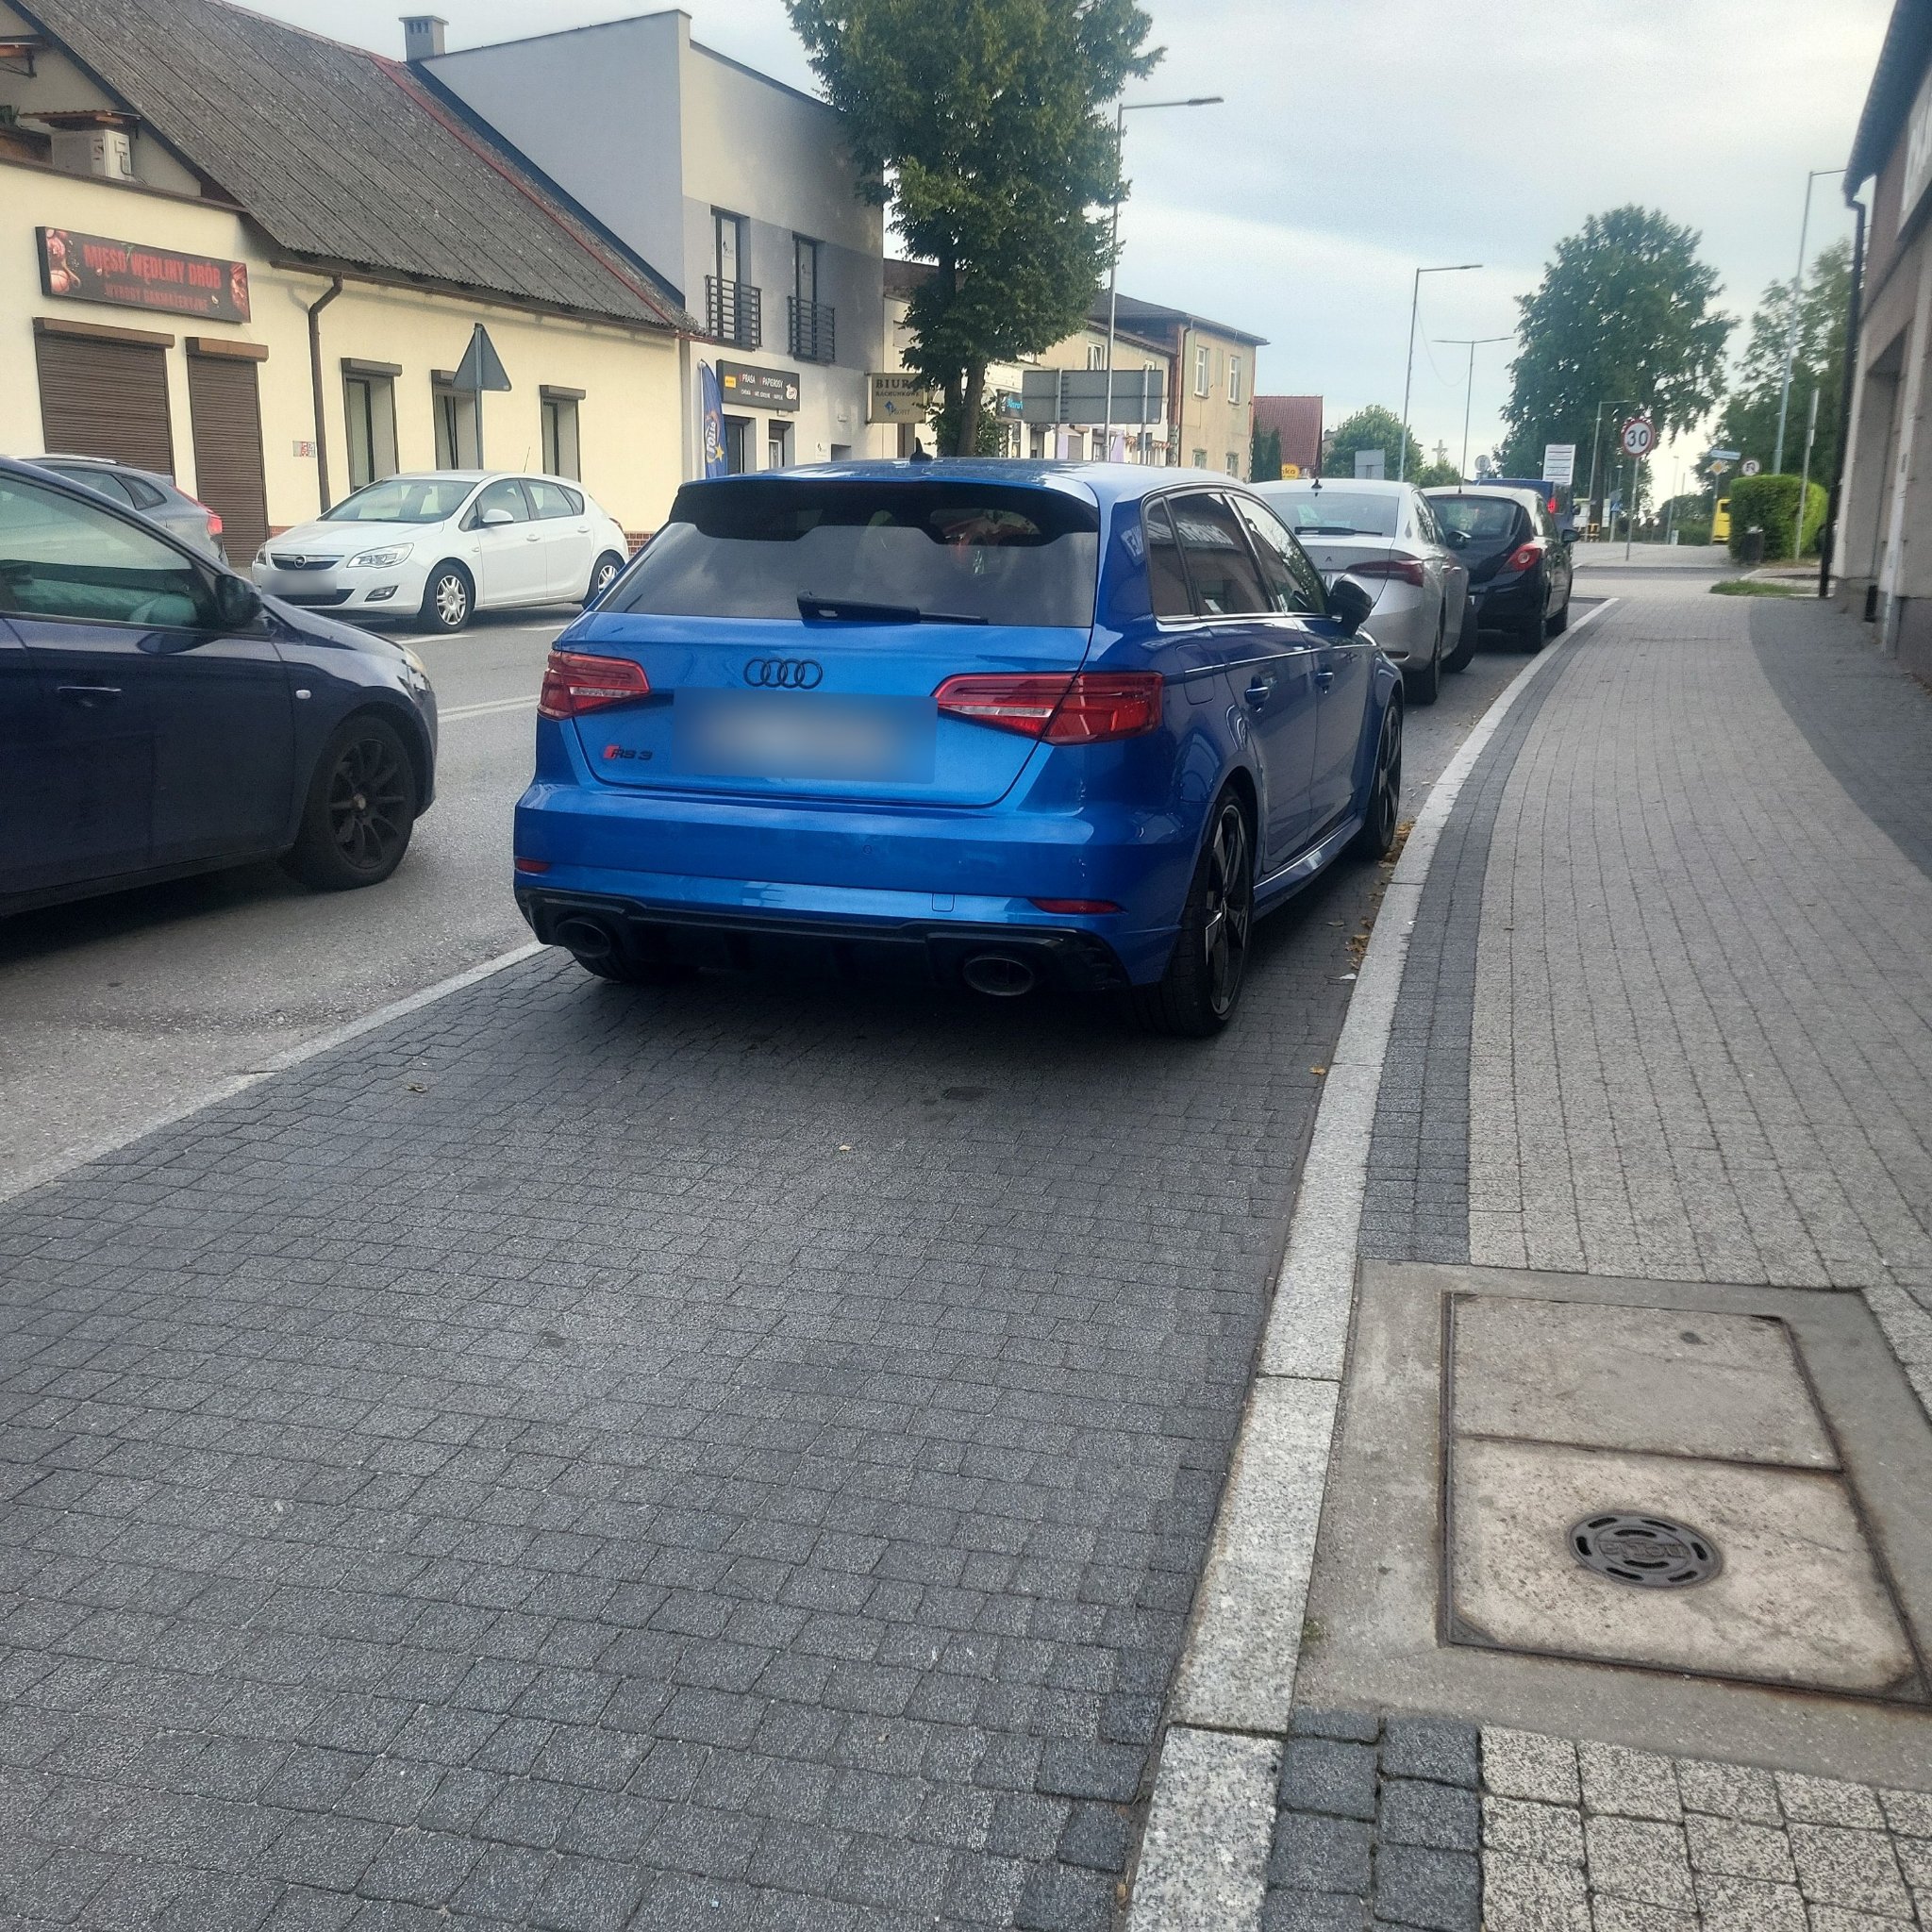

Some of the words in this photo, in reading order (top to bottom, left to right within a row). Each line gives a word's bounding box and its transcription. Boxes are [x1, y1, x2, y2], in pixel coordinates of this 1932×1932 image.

[131, 252, 184, 285] WĘDLINY
[188, 262, 222, 290] DRÓB
[875, 379, 914, 389] BIUR
[1626, 429, 1649, 447] 30
